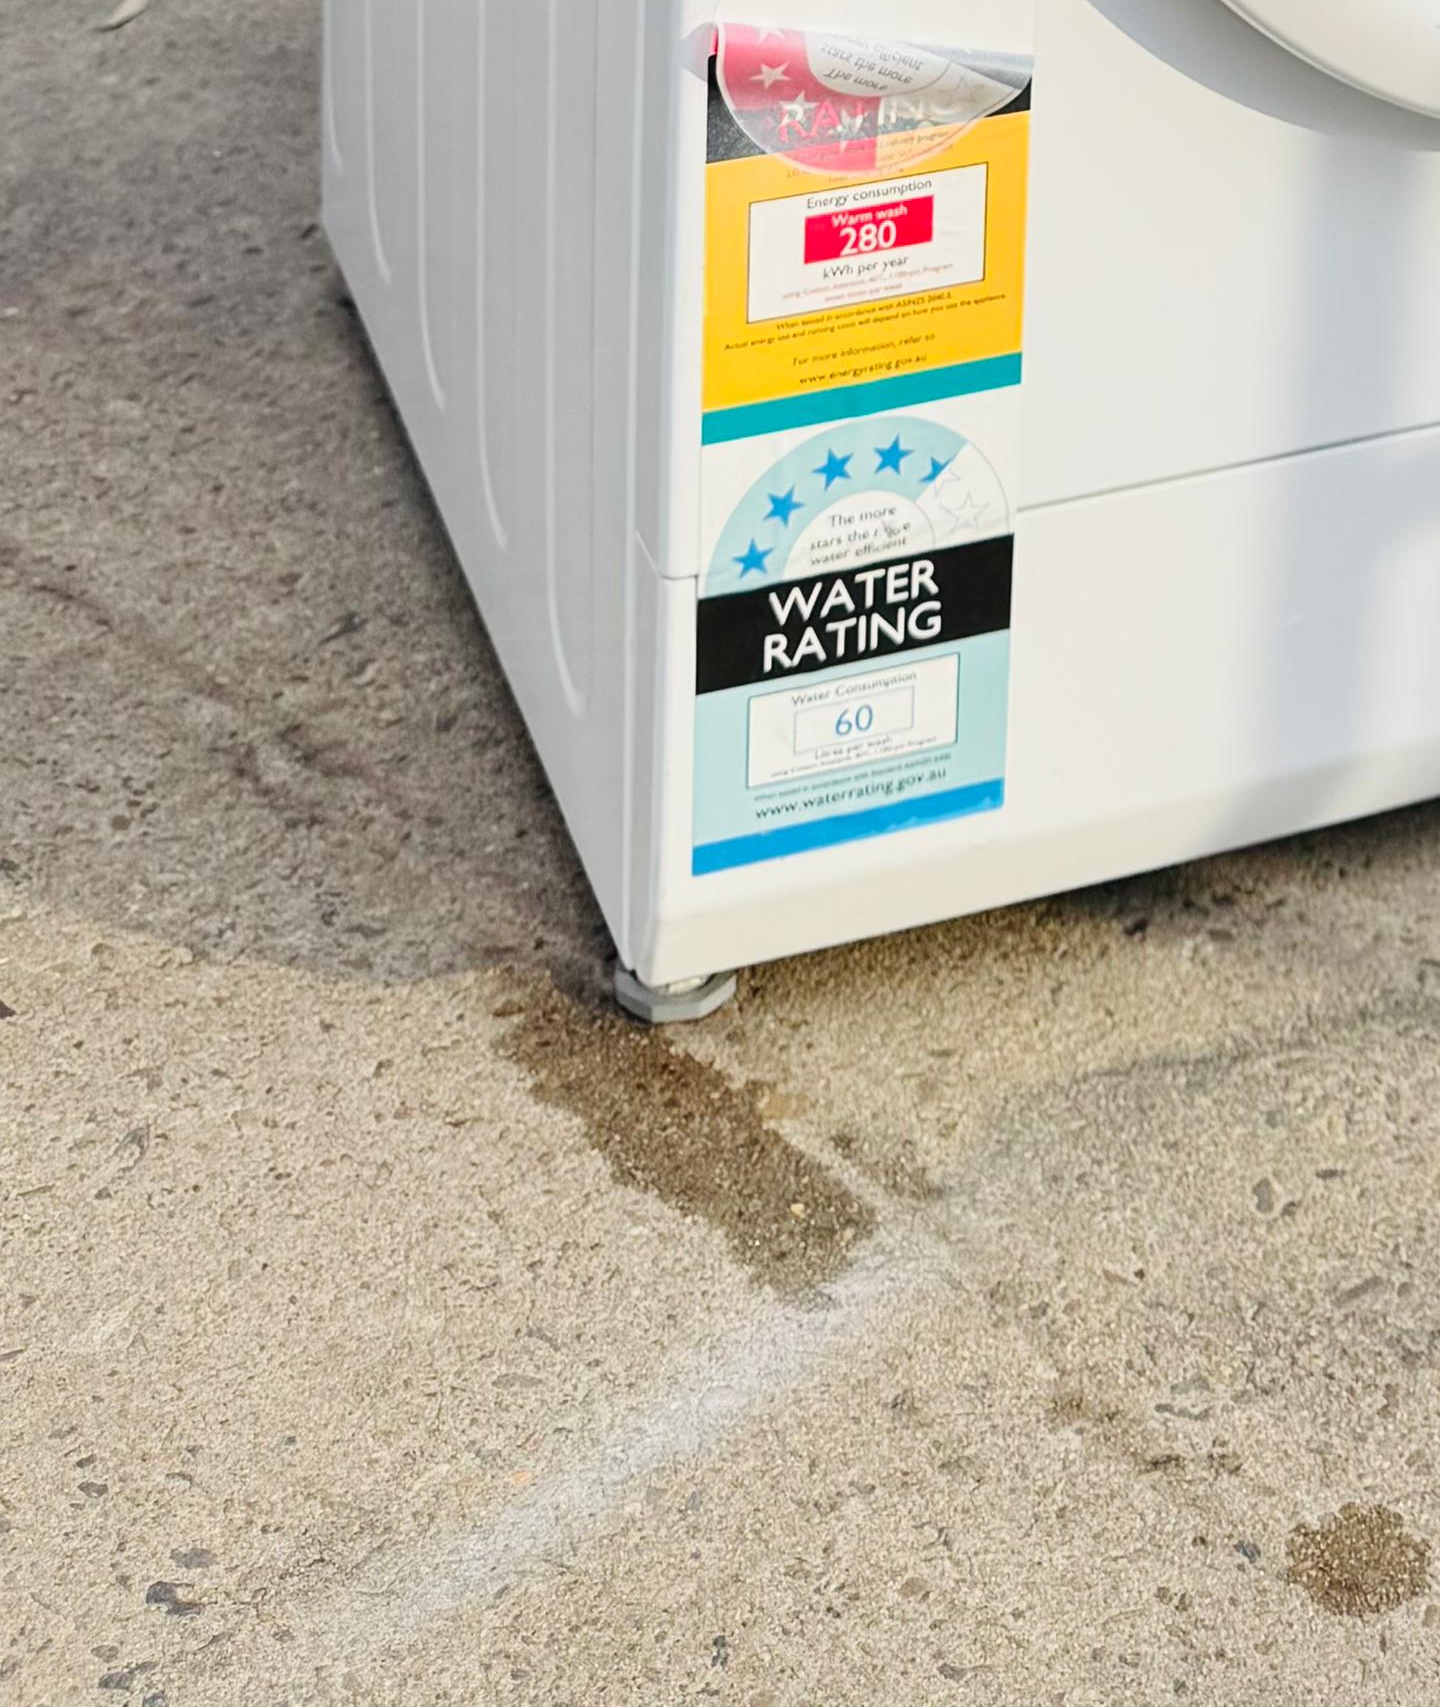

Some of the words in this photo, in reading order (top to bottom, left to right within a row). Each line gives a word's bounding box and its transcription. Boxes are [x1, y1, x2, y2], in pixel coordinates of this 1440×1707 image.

[807, 194, 848, 209] Energy
[853, 179, 932, 202] consumption
[832, 211, 872, 227] Warm
[875, 204, 908, 220] wash
[839, 220, 896, 257] 280
[823, 266, 853, 279] kWh
[857, 264, 878, 276] per
[882, 256, 909, 272] year
[830, 514, 855, 528] The
[859, 506, 896, 522] more
[810, 535, 842, 551] stars
[847, 529, 869, 543] the
[810, 551, 849, 566] water
[855, 537, 907, 558] efficient
[769, 559, 939, 627] WATER
[763, 600, 942, 674] RATING
[792, 689, 830, 706] Water
[835, 672, 917, 697] Consumption
[835, 704, 873, 736] 60
[755, 768, 947, 819] www.waterrating.gov.au
